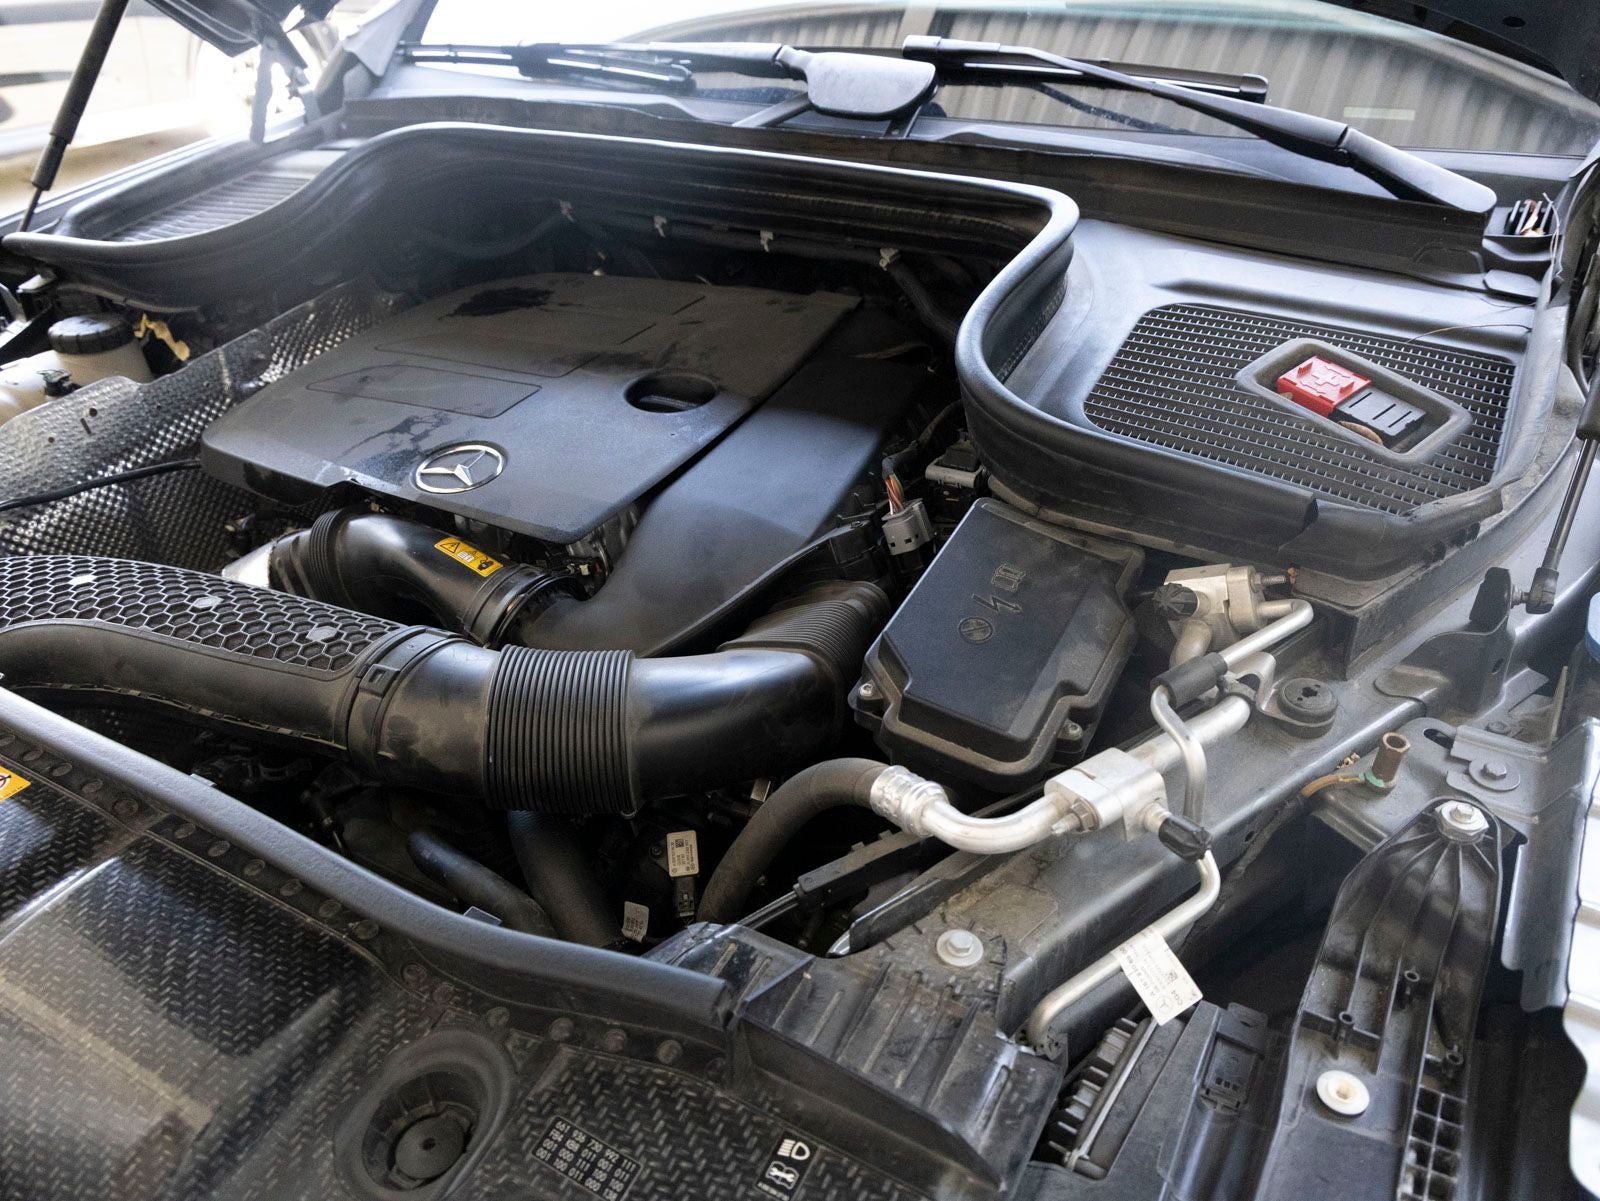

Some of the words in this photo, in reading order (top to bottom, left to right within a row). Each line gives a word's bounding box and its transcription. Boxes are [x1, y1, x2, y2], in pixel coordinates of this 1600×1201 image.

[536, 1147, 551, 1161] 001
[543, 1138, 558, 1151] 001
[576, 1158, 590, 1171] 111
[581, 1149, 596, 1162] 011
[597, 1158, 613, 1172] 001
[614, 1168, 630, 1182] 011
[621, 1159, 636, 1172] 111
